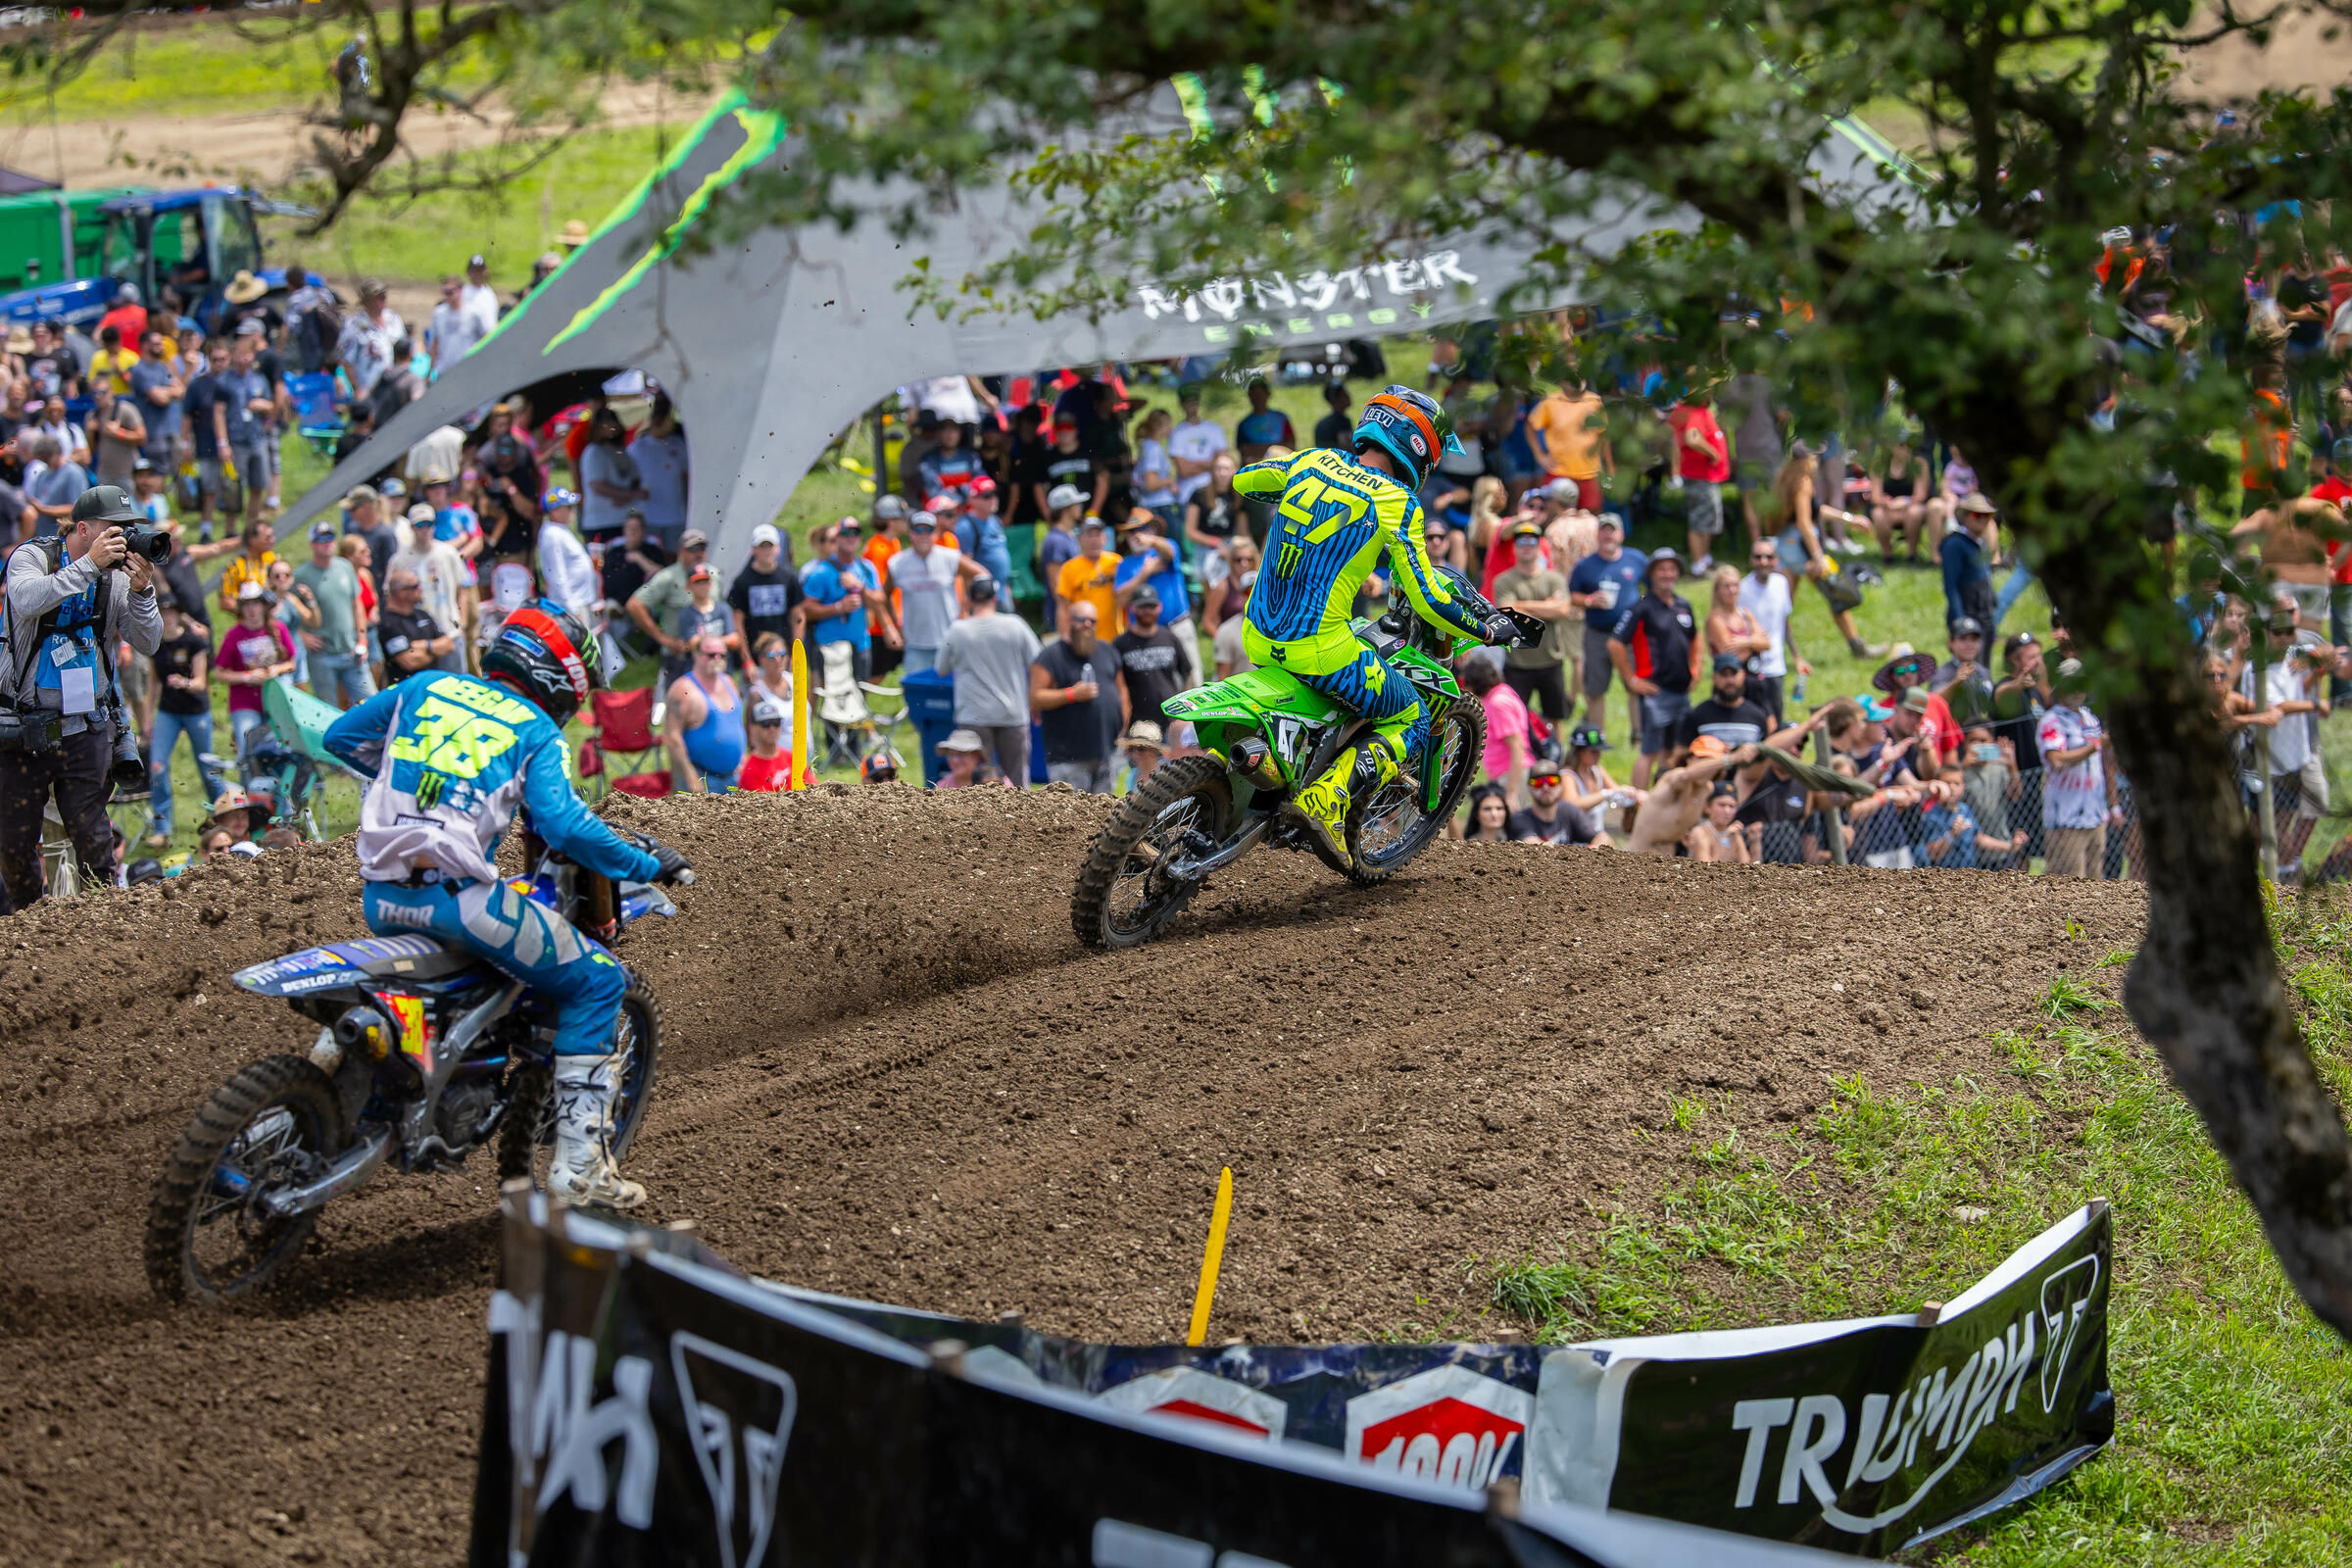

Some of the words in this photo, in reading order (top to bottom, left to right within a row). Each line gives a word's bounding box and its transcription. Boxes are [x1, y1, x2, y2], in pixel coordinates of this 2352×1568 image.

[1138, 250, 1478, 321] MONSTER
[1204, 302, 1434, 342] ENERGY
[1365, 408, 1395, 428] LEVI
[1412, 437, 1424, 453] BELL
[1317, 454, 1383, 490] KITCHEN
[1278, 475, 1370, 545] 47
[1460, 612, 1478, 629] FOX
[1392, 657, 1453, 691] KX
[426, 676, 537, 725] DEEGAN
[387, 696, 519, 779] 38
[1277, 718, 1301, 763] 47
[1360, 749, 1376, 773] FOX
[376, 899, 434, 927] THOR
[281, 973, 336, 993] DUNLOP
[1733, 1310, 2036, 1535] TRIUMPH
